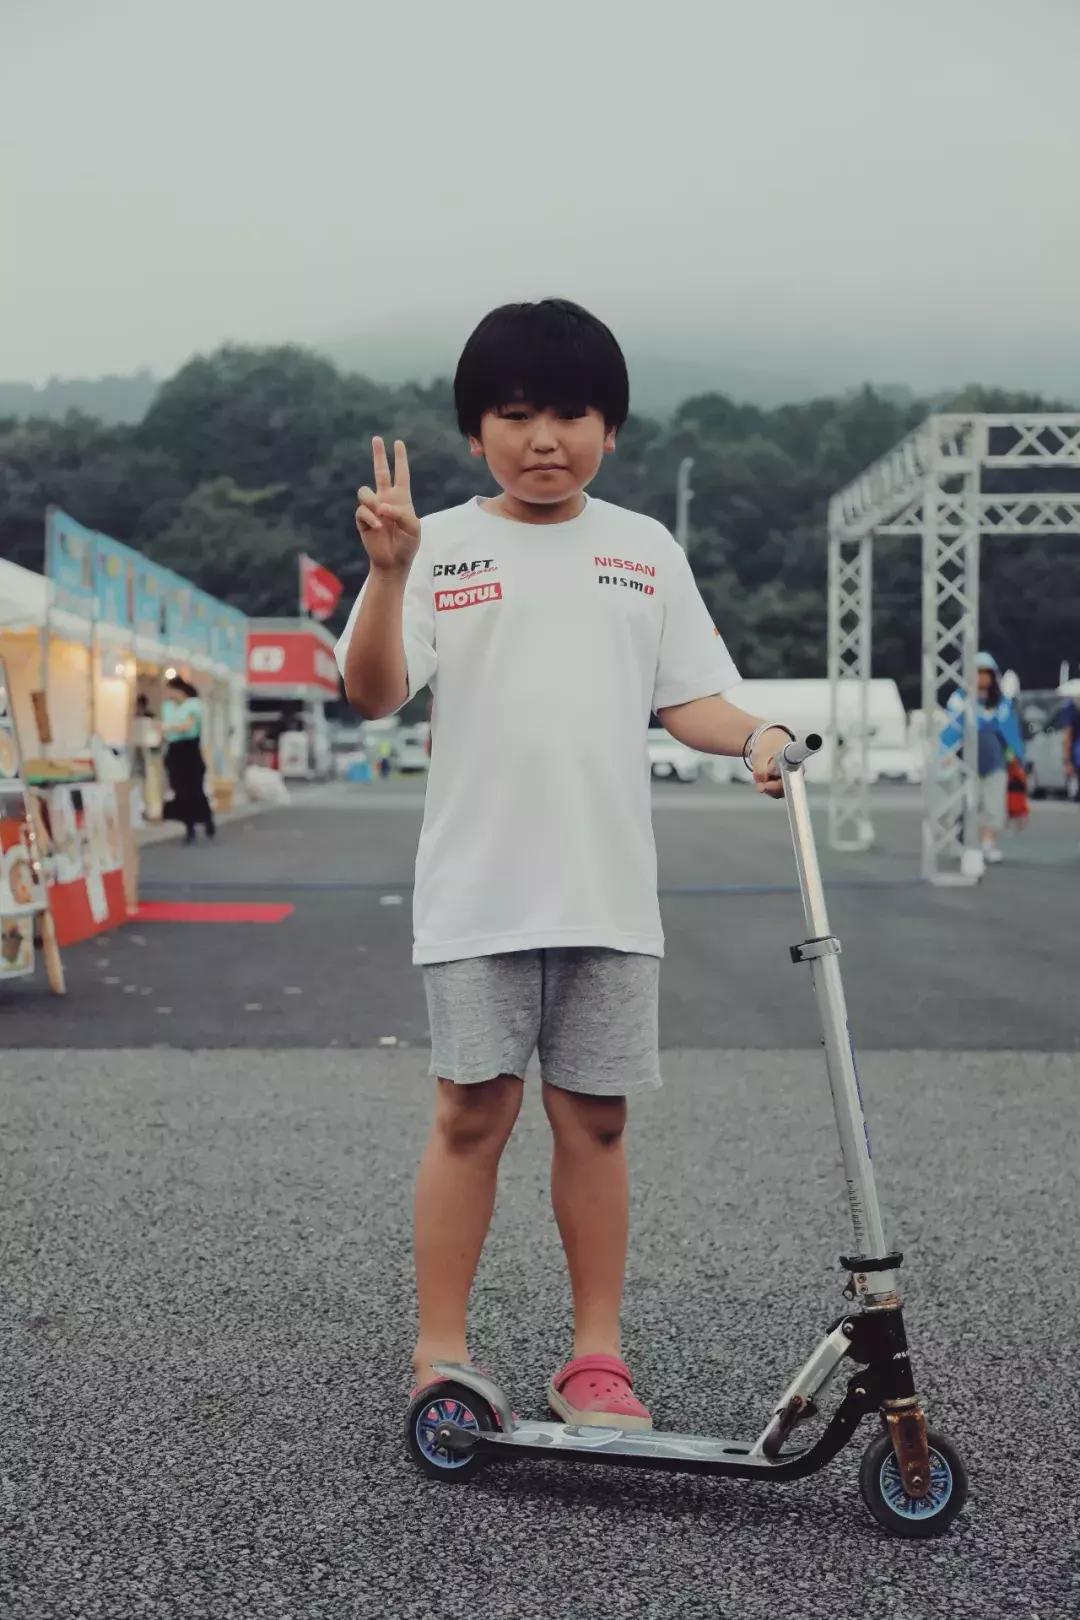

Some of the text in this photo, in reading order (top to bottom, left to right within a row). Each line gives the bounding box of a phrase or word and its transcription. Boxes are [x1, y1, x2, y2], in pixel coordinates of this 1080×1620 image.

[433, 559, 494, 577] CRAFT
[594, 557, 655, 576] NISSAN
[598, 575, 655, 595] nismo
[439, 583, 499, 608] MOTUL
